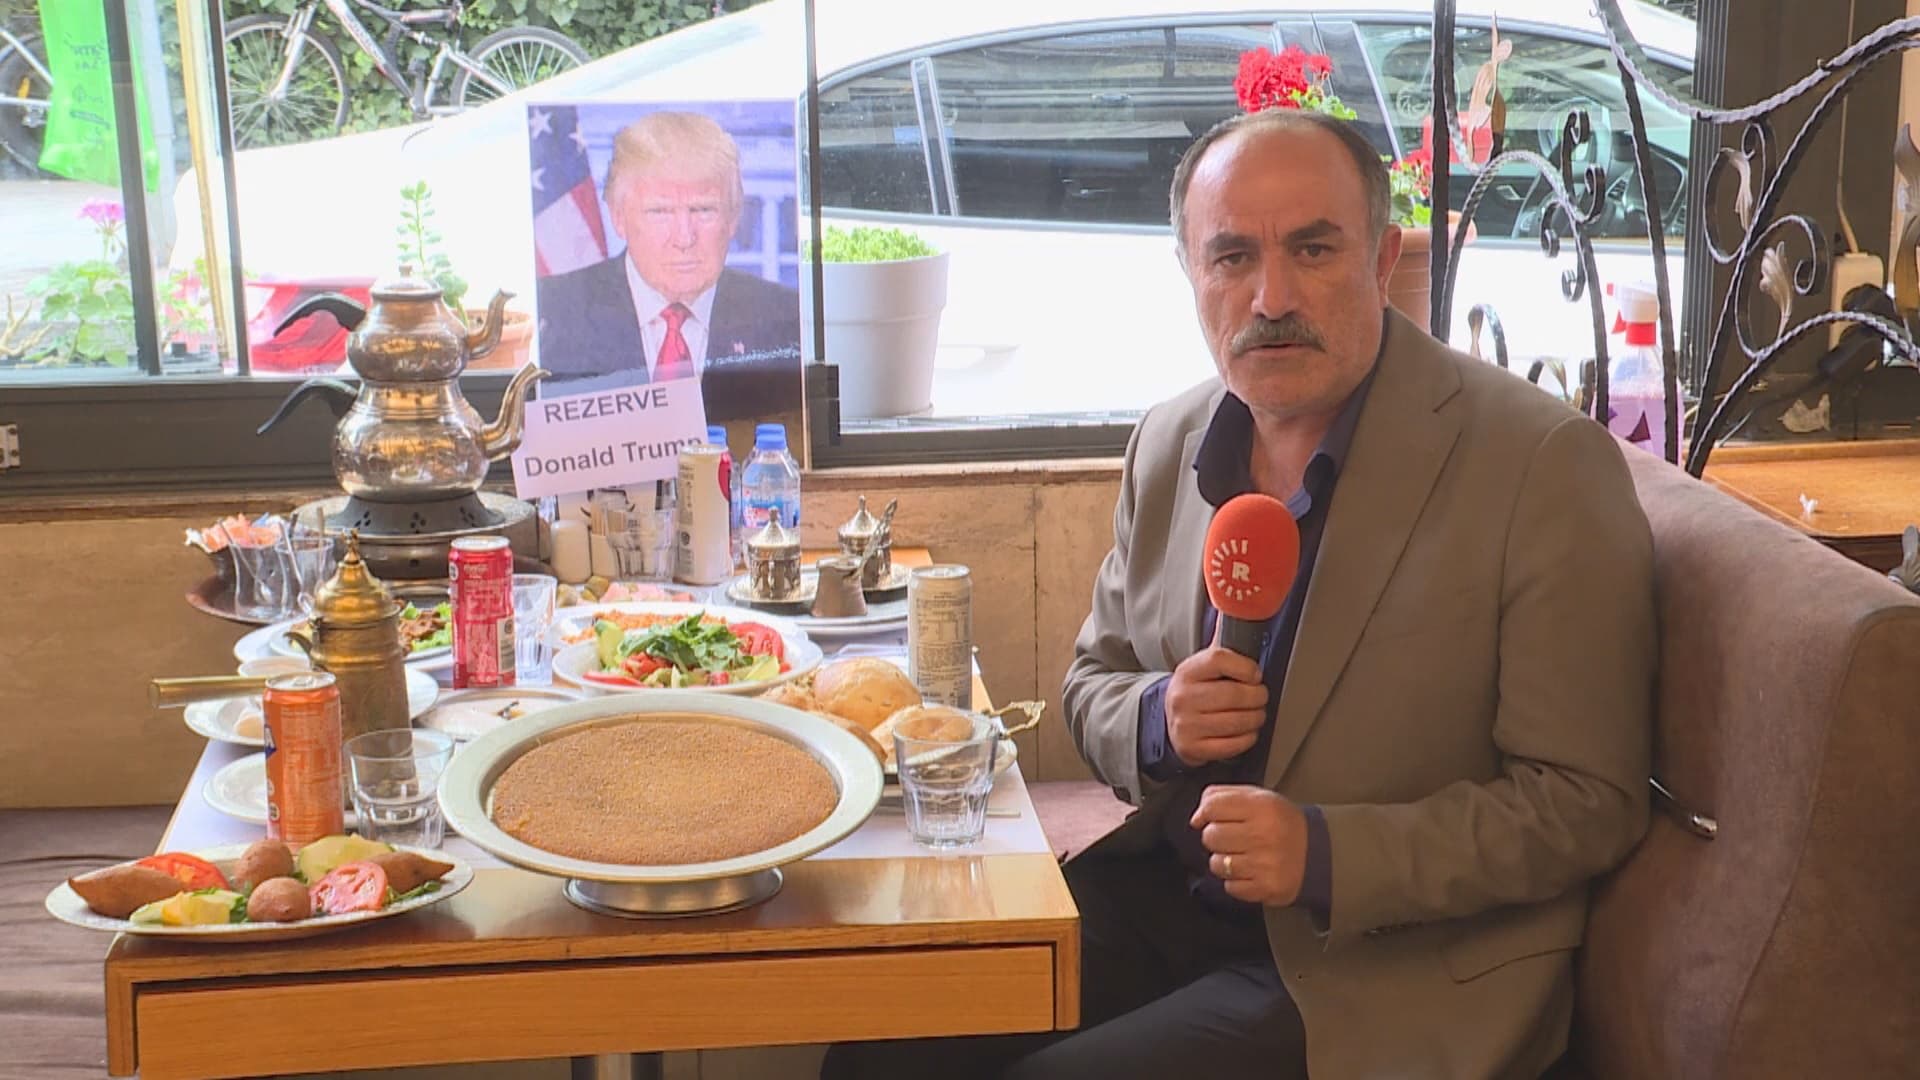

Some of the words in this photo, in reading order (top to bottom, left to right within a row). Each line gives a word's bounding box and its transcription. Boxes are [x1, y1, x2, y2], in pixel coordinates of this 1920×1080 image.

[544, 387, 668, 424] REZERVE
[525, 446, 615, 477] Donald
[1232, 561, 1250, 582] R
